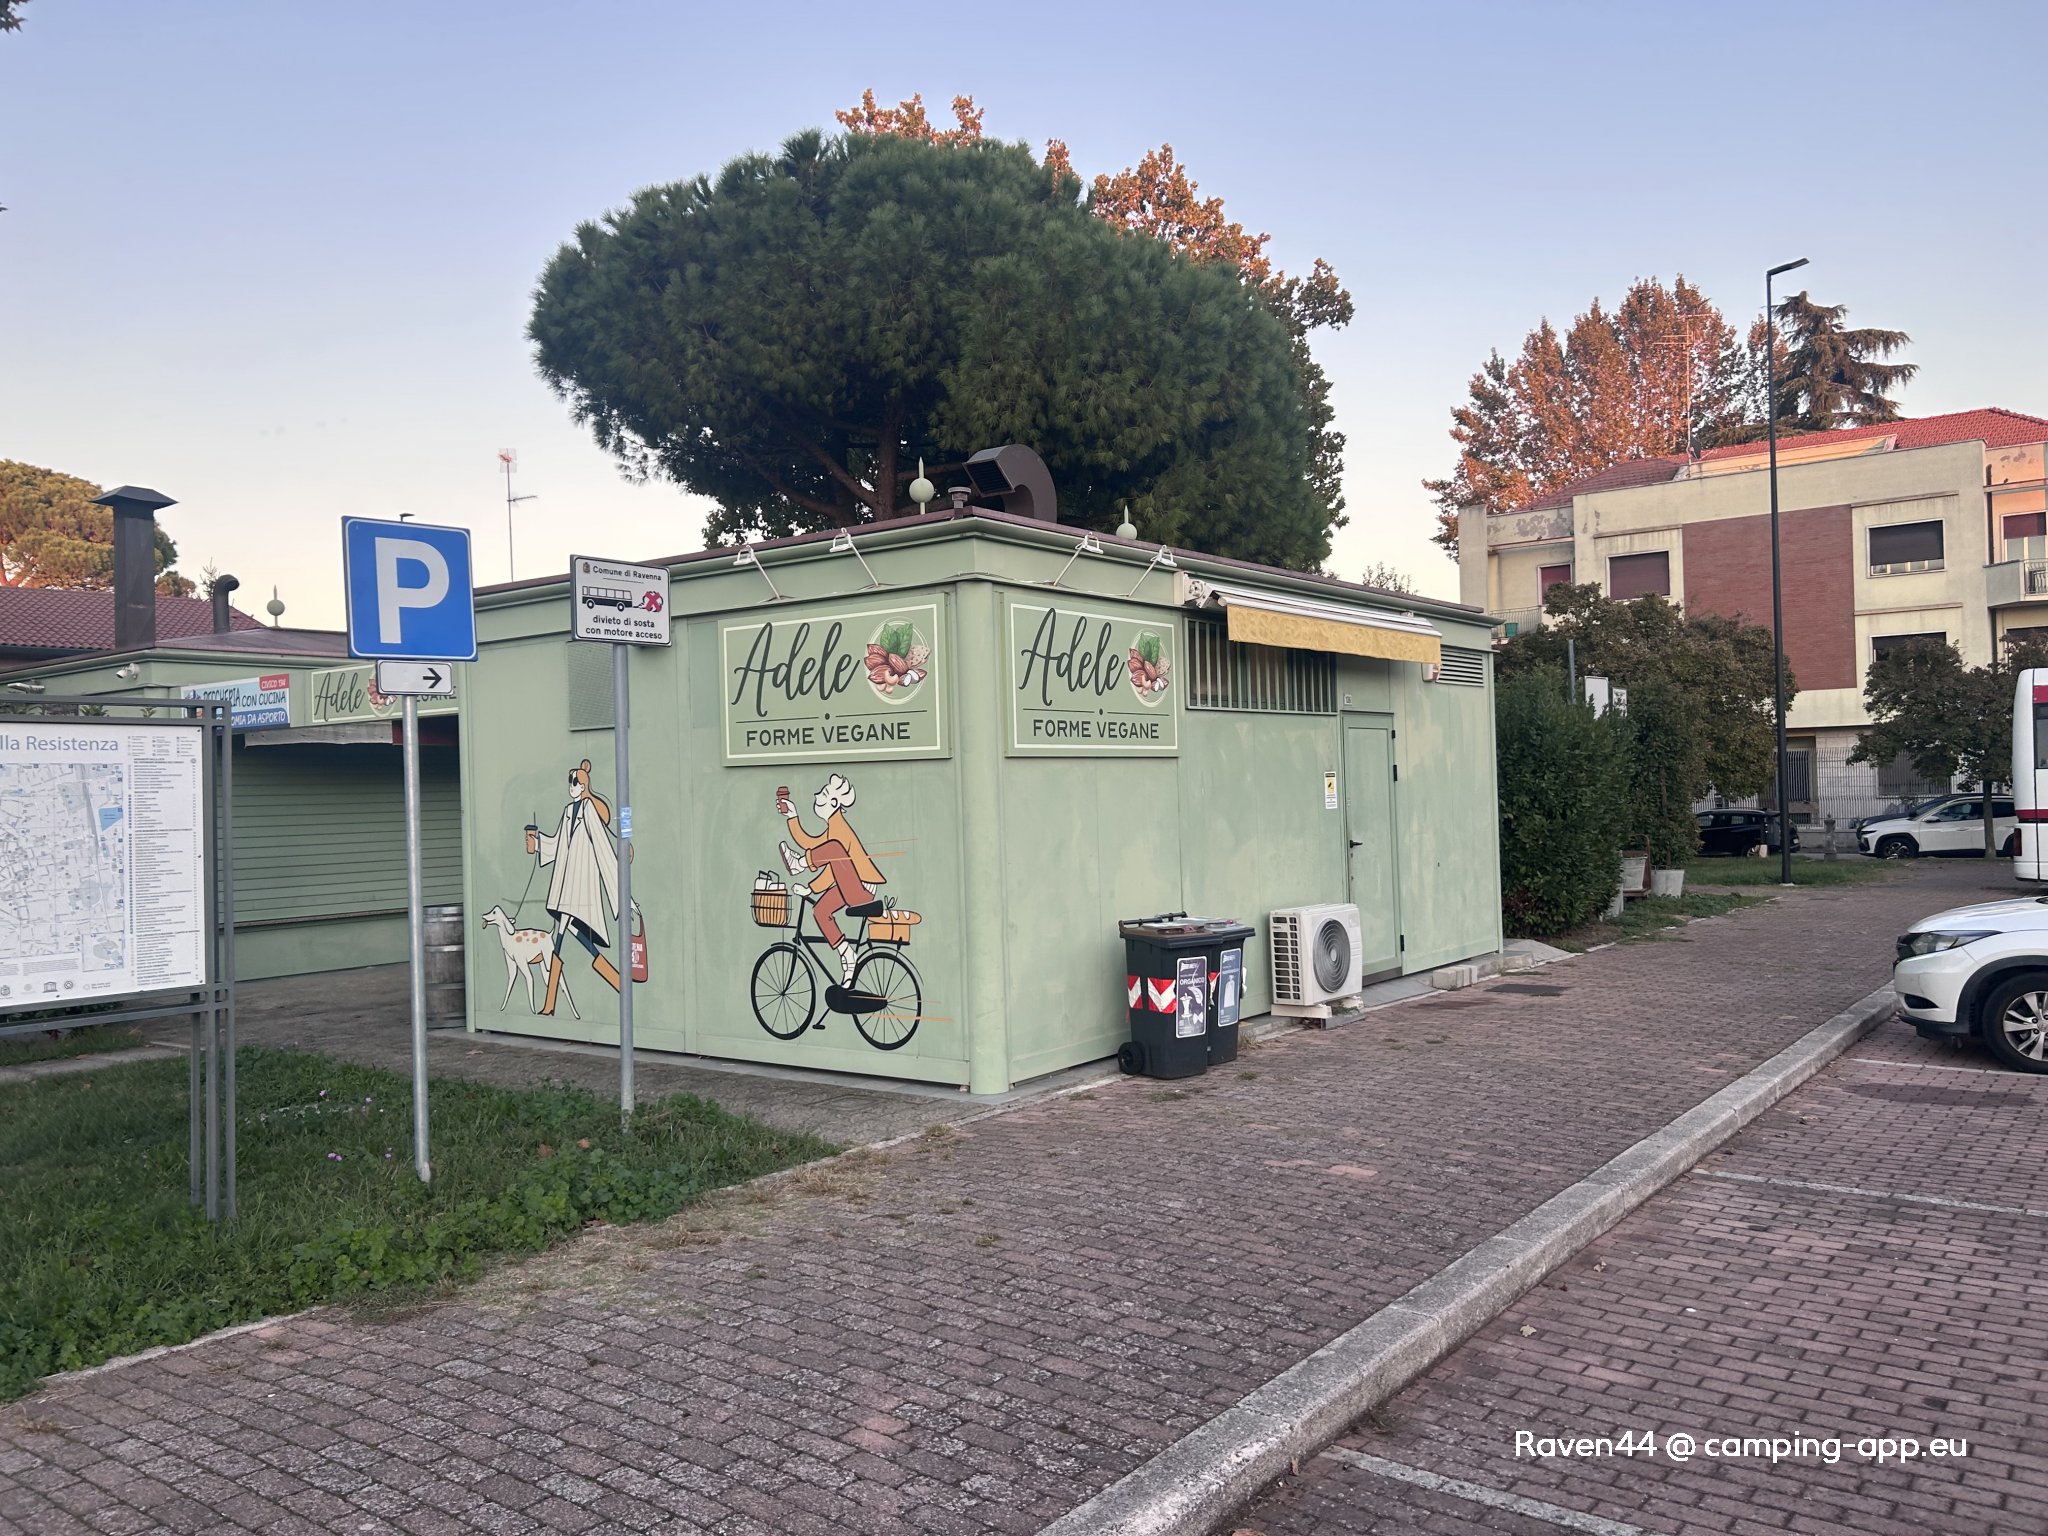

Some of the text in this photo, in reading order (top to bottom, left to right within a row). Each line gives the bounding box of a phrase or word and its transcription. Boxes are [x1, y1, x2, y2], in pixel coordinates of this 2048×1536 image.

[593, 565, 662, 581] Comune di Ravenna
[375, 537, 450, 643] P
[593, 615, 655, 628] divieto di sosta
[585, 627, 663, 640] con motore acceso
[1018, 607, 1125, 706] Adele
[731, 621, 859, 717] Adele
[242, 695, 257, 708] CON
[259, 690, 287, 706] CUCINA
[314, 672, 365, 722] Adele
[247, 714, 257, 725] DA
[257, 710, 286, 724] ASPORTO
[746, 721, 911, 747] FORME VEGANE
[1033, 719, 1160, 739] FORME VEGANE
[26, 736, 118, 751] Resistenza
[1180, 976, 1205, 986] ORGANICO
